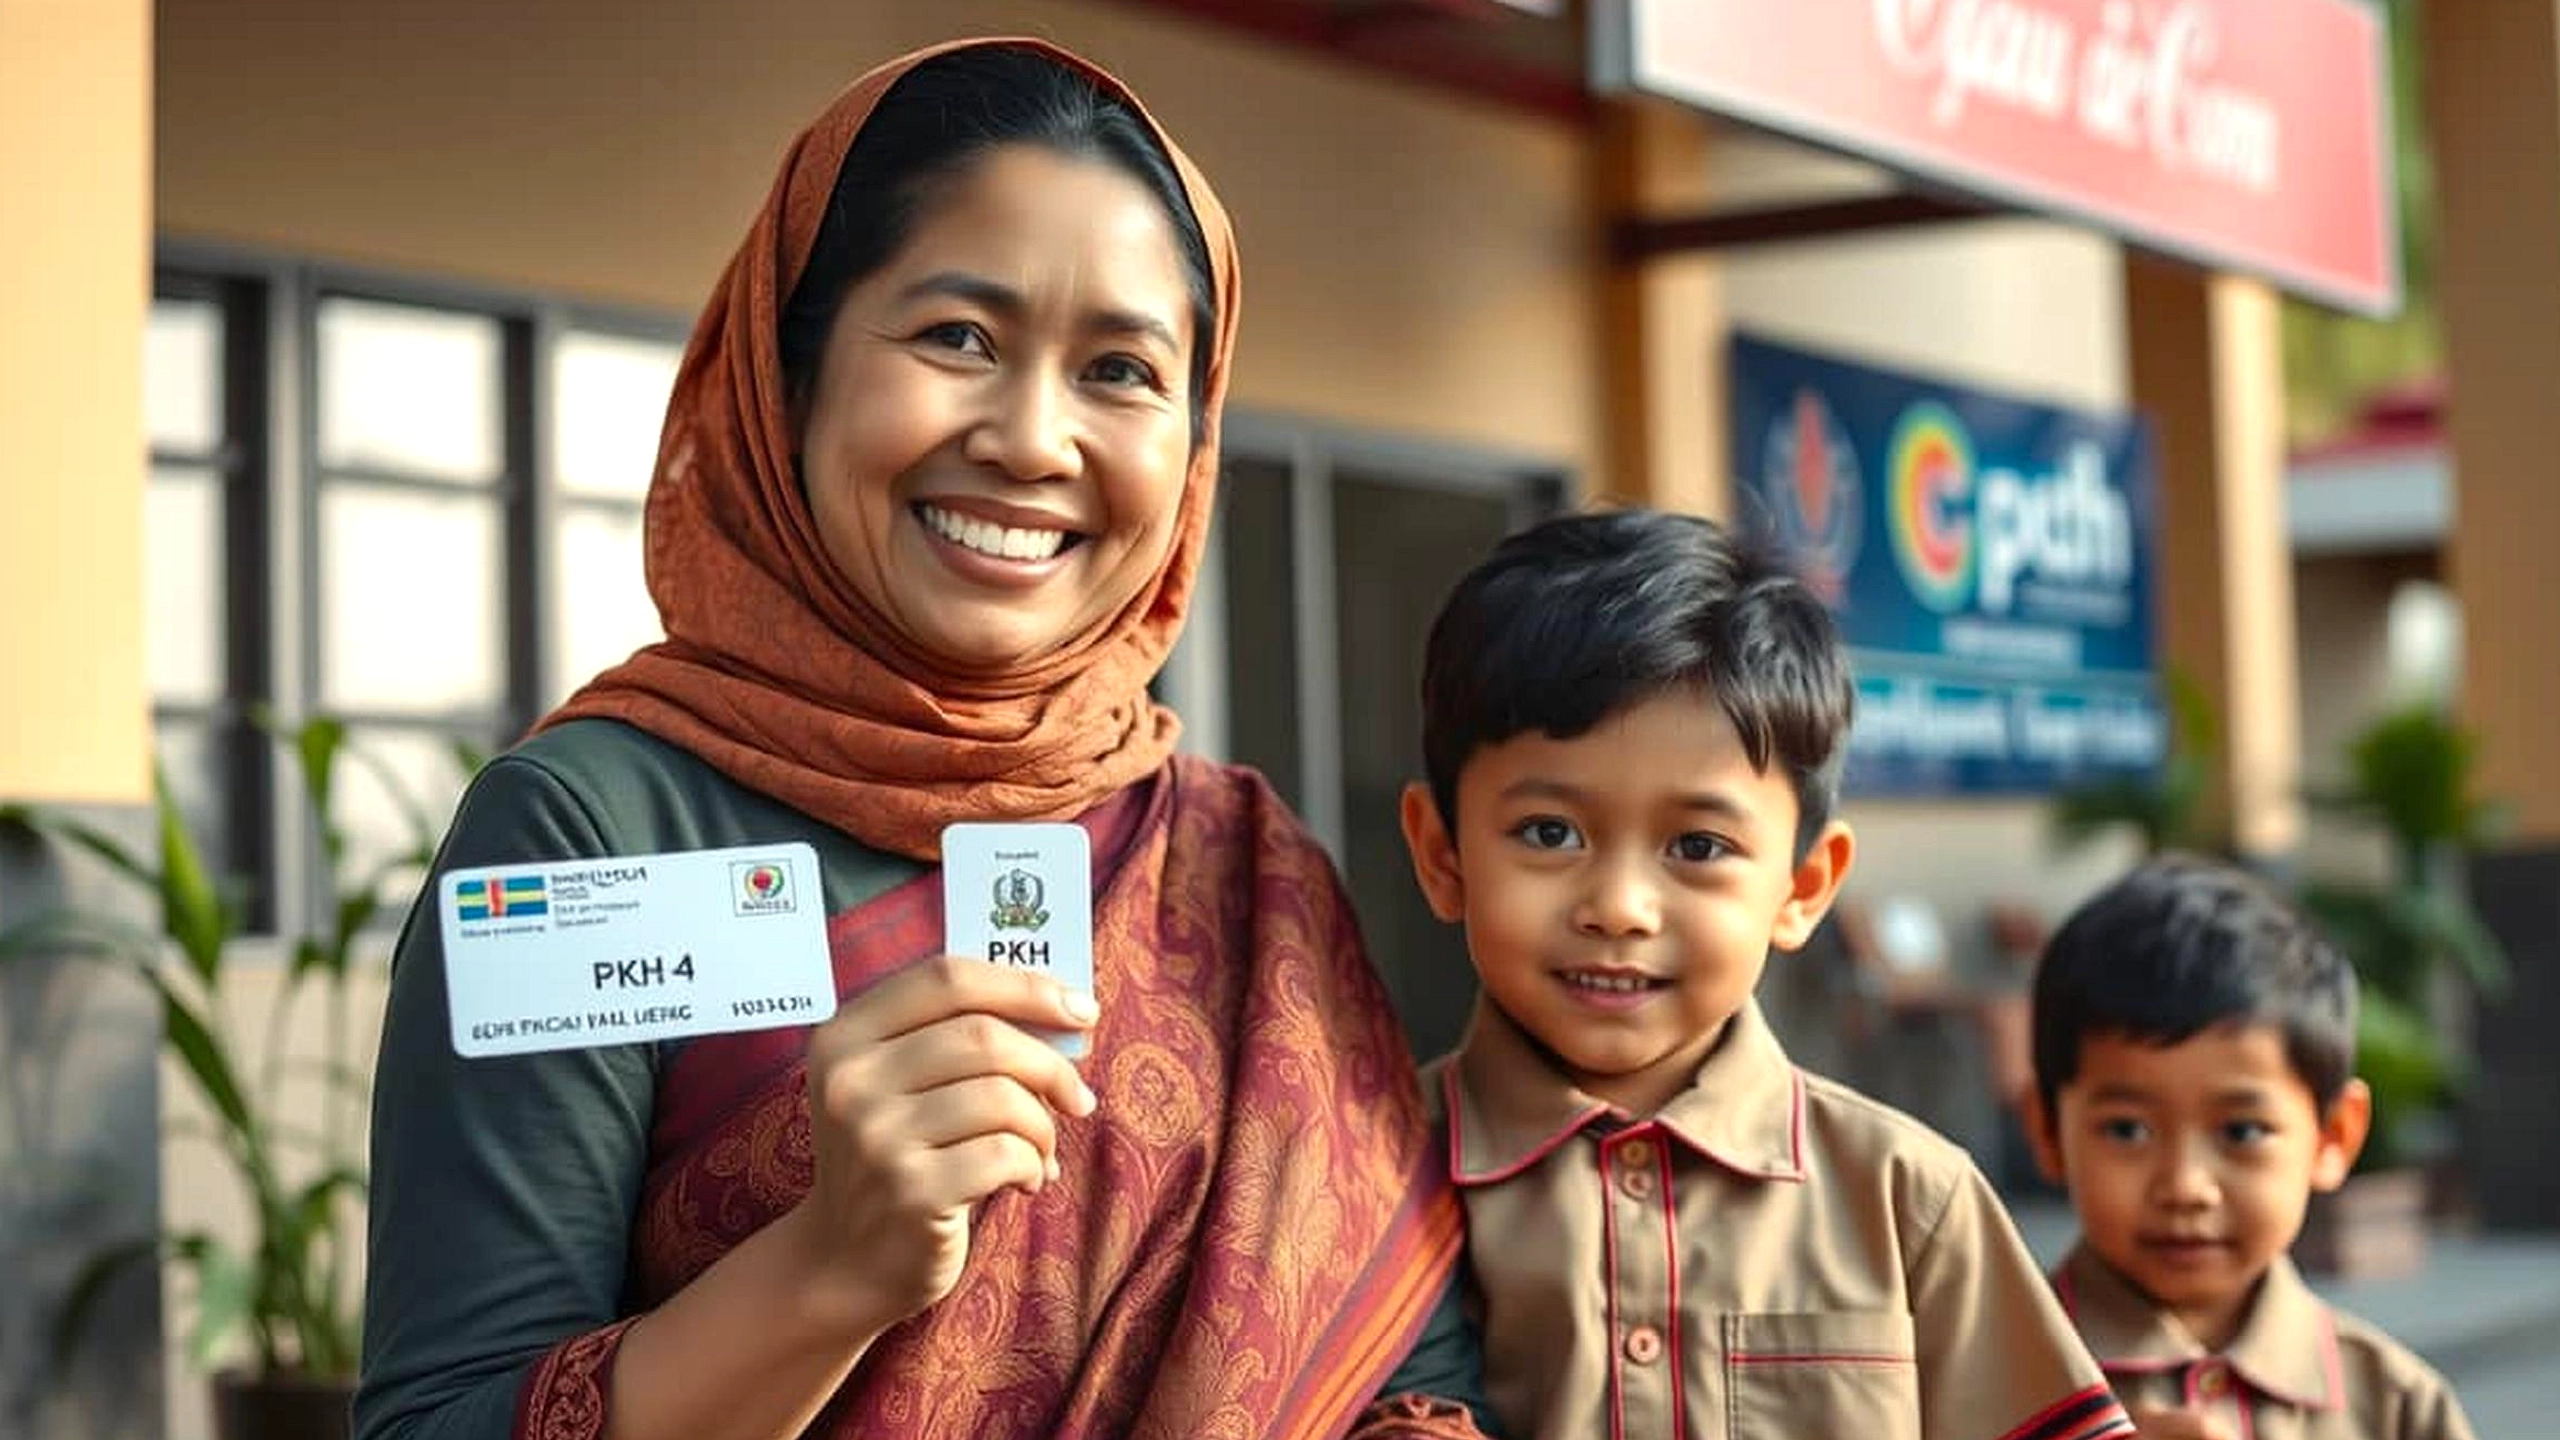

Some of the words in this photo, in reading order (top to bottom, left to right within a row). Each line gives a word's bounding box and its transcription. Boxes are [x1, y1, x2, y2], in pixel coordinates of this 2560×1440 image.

[987, 940, 1050, 965] PKH
[593, 957, 665, 990] PKH
[673, 953, 695, 982] 4
